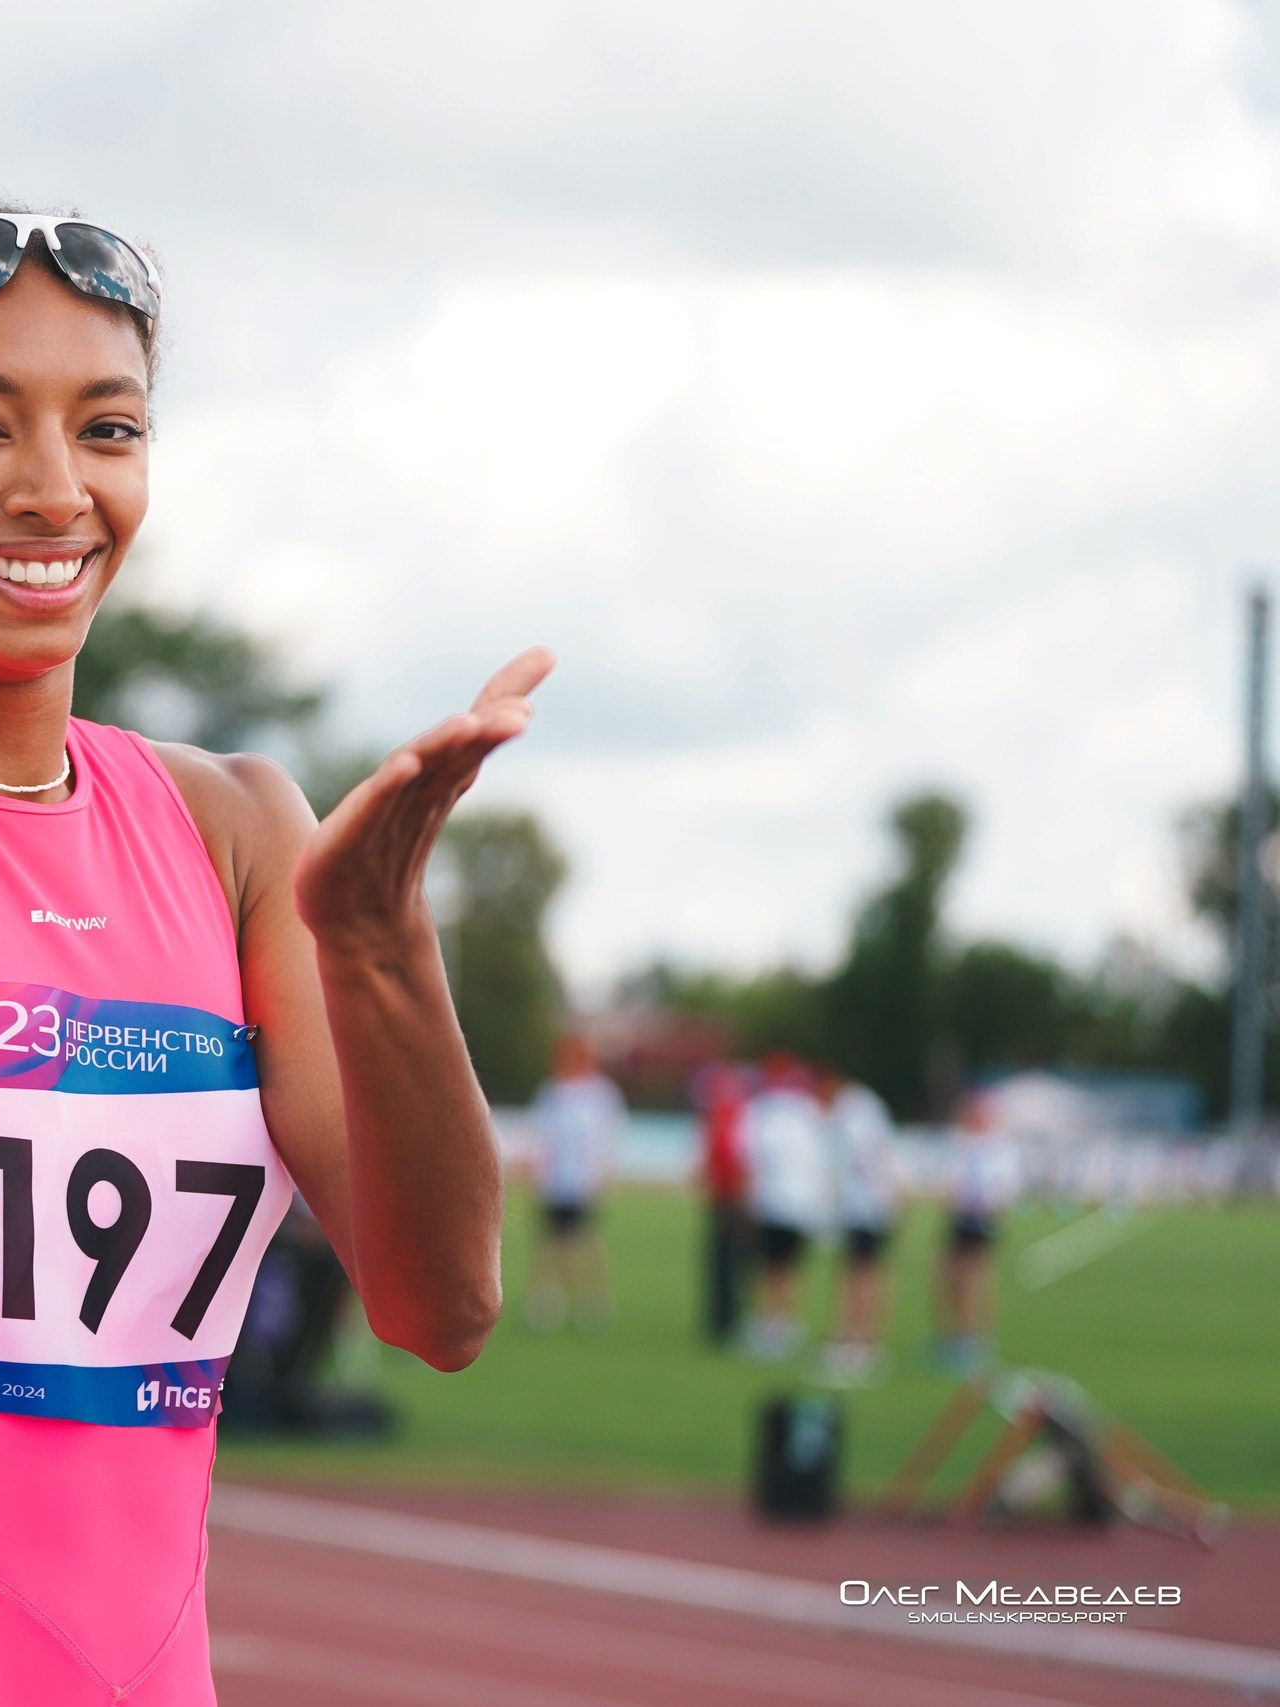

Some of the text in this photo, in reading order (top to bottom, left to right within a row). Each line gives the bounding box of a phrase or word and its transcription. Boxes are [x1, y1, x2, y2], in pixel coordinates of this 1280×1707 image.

[65, 1018, 224, 1057] ПЕРВЕНСТВО
[65, 1042, 167, 1073] РОССИИ
[2, 1383, 46, 1400] 2024
[164, 1386, 211, 1409] ПСБ
